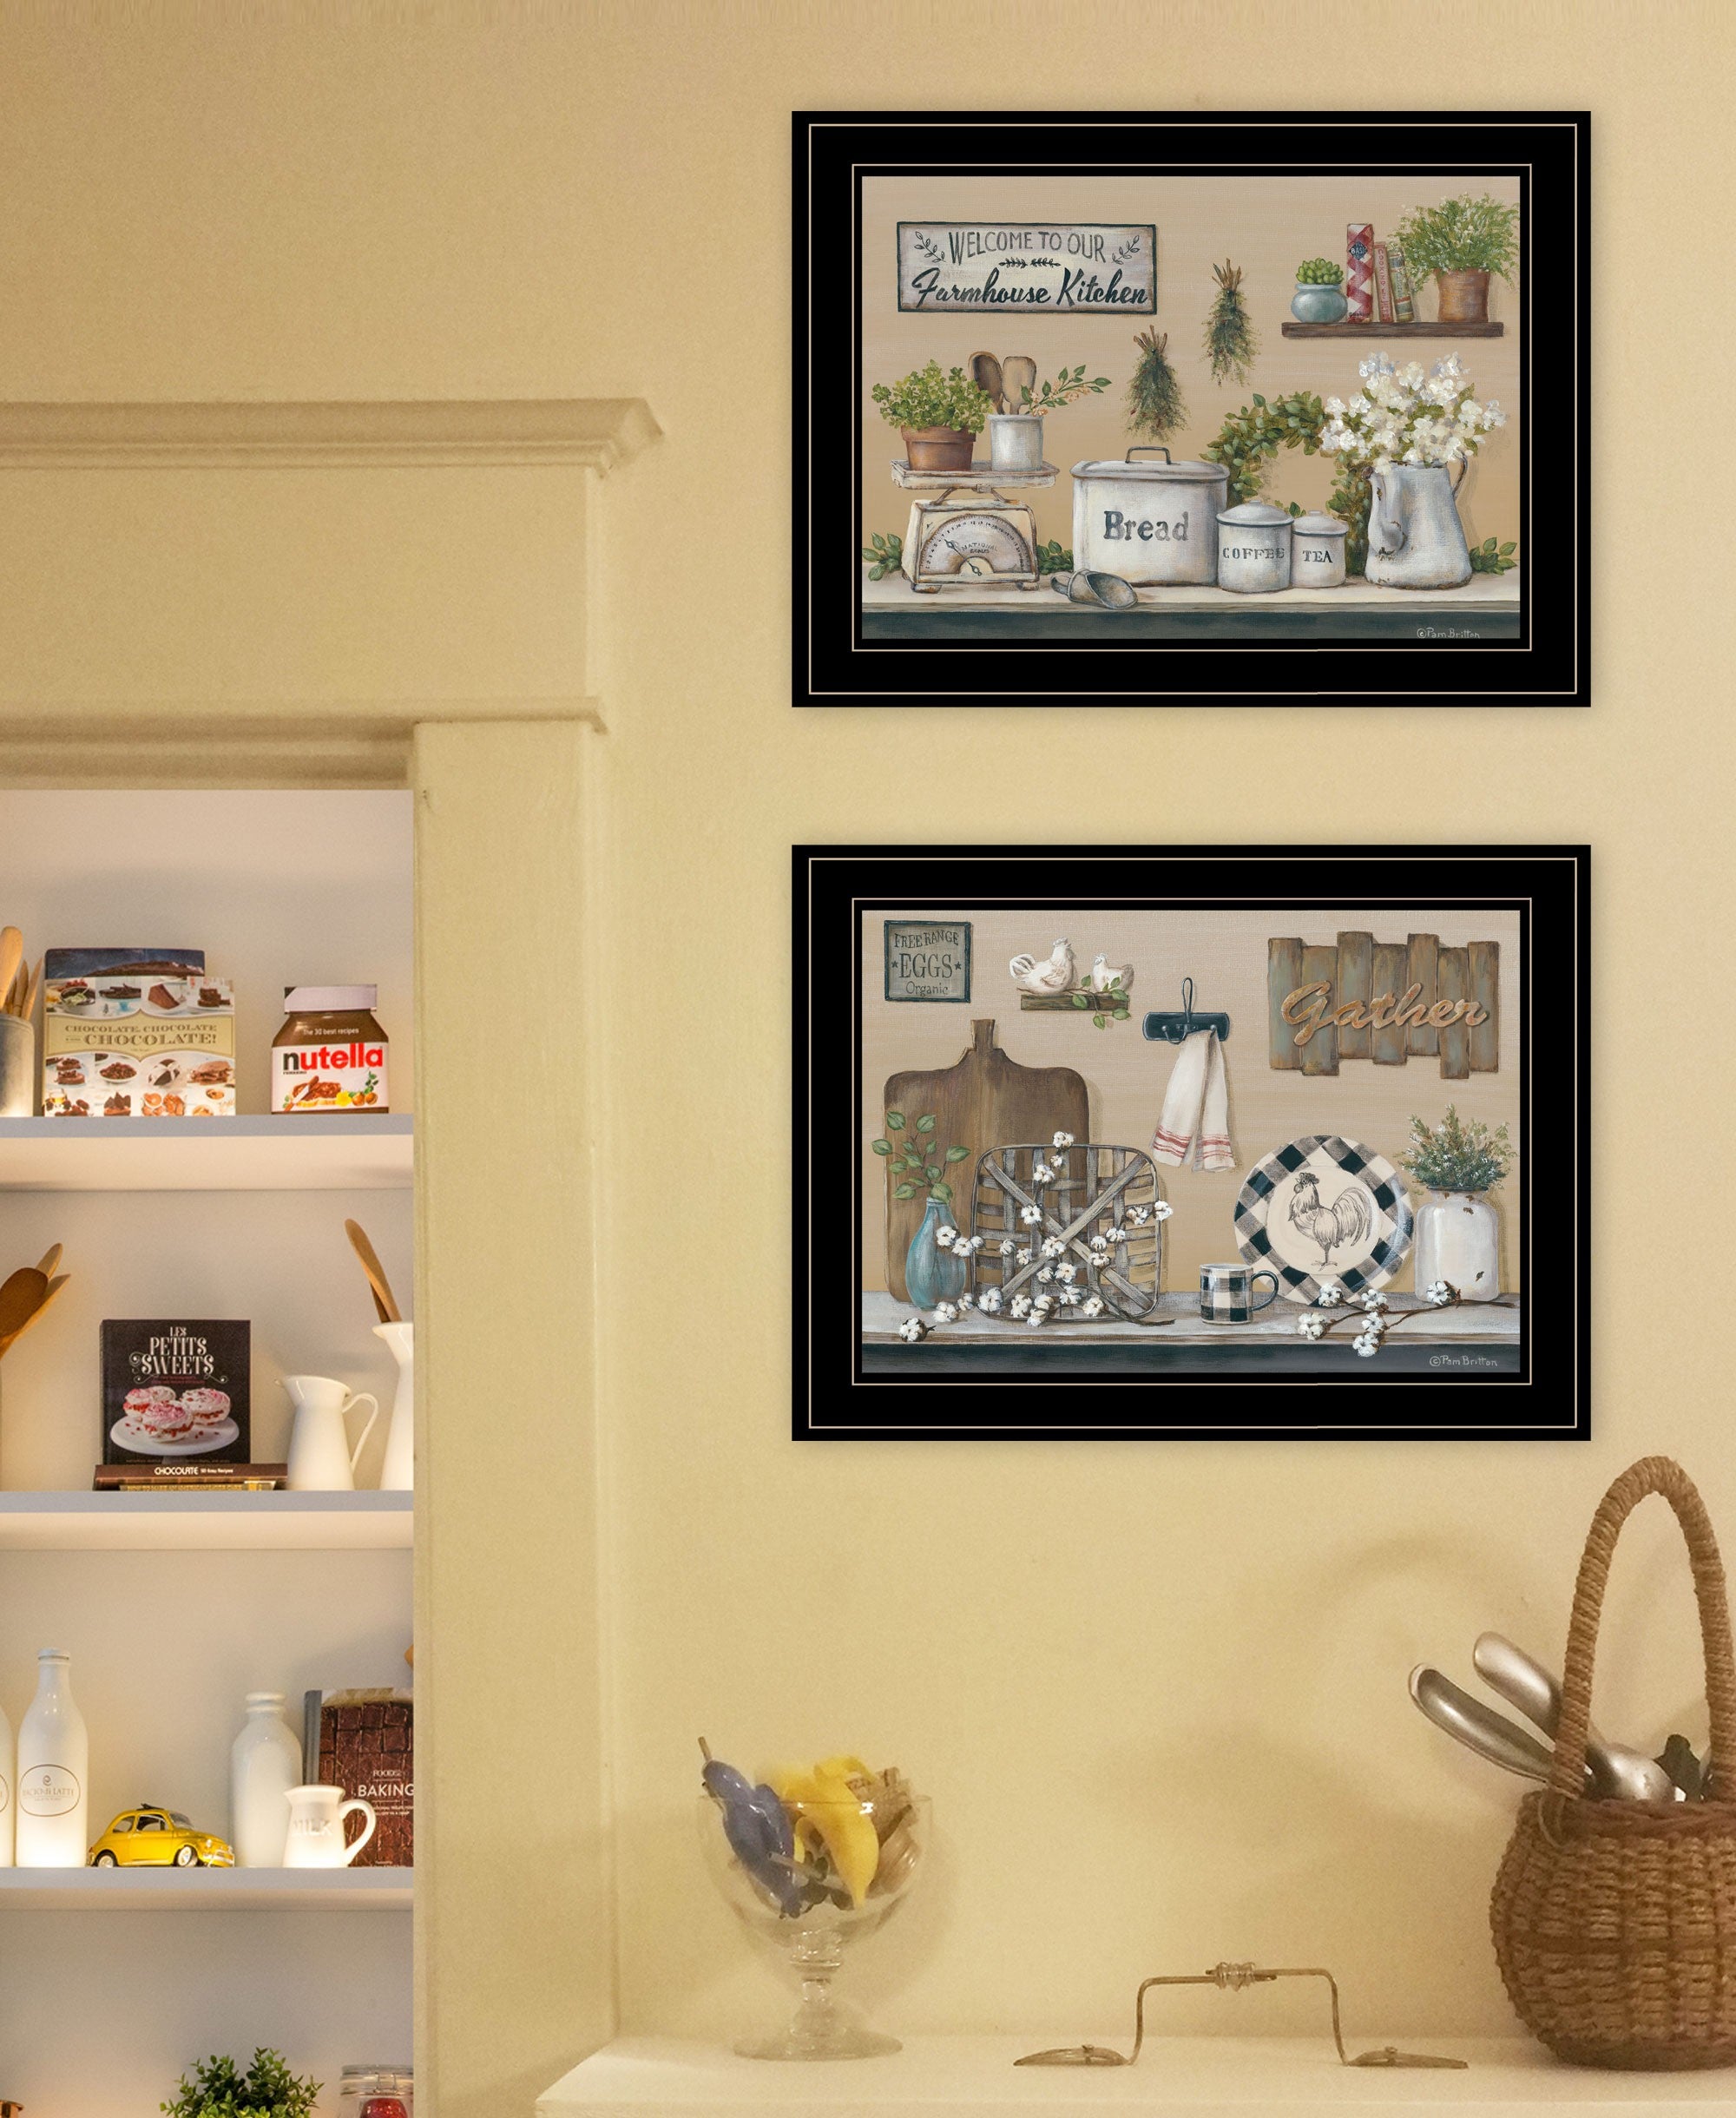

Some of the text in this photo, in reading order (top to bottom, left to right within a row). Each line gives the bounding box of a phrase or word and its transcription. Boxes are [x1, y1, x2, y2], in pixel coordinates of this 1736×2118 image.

[948, 231, 1106, 266] WELCOME TO OUR
[911, 266, 1147, 308] Farmhouse Kitchen
[1103, 510, 1189, 543] Bread
[1222, 547, 1333, 563] COFFEE TEA
[1448, 628, 1481, 639] Britton
[894, 930, 959, 949] FREE RANGE
[898, 953, 953, 978] EGGS
[905, 981, 949, 997] Organic
[1281, 980, 1488, 1046] Gather
[84, 1033, 217, 1045] CHOCOLATE!
[283, 1043, 383, 1070] nutella
[170, 1326, 186, 1337] LES
[150, 1337, 207, 1356] PETITS
[141, 1355, 214, 1375] SWEETS
[1462, 1355, 1498, 1366] Britton
[154, 1466, 199, 1475] CHOCOLATE
[358, 1783, 414, 1797] BAKING
